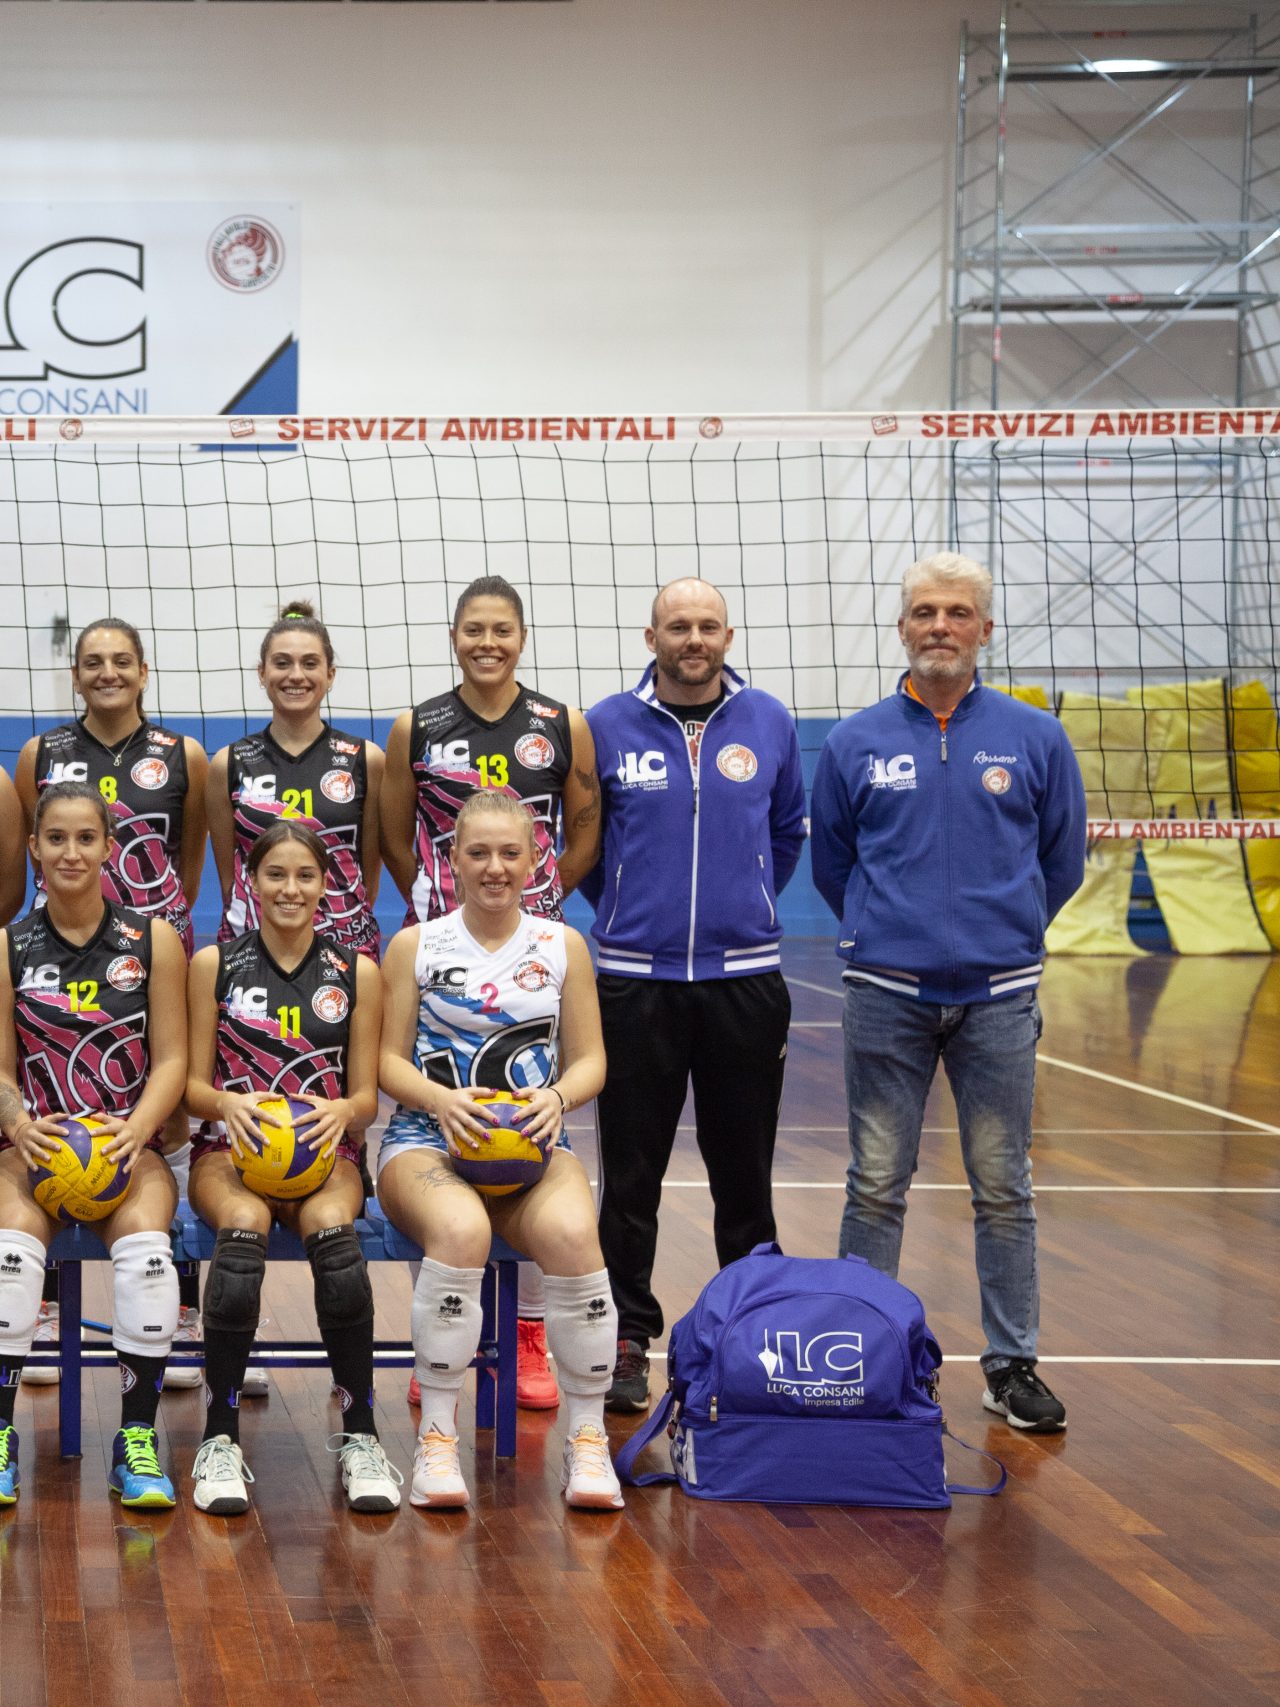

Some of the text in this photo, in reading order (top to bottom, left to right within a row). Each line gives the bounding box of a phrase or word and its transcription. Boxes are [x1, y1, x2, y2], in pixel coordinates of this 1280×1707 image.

[277, 416, 427, 441] SERVIZI
[441, 416, 676, 441] AMBIENTALI
[921, 412, 1075, 438] SERVIZI
[476, 754, 510, 788] 13
[623, 751, 668, 784] LC
[874, 754, 917, 783] LC
[973, 751, 1018, 765] Rossano
[99, 775, 118, 805] 8
[281, 788, 314, 819] 21
[1130, 822, 1280, 839] AMBIENTAL
[66, 980, 100, 1013] 12
[480, 982, 501, 1014] 2
[277, 1005, 300, 1039] 11
[772, 1331, 863, 1386] LC
[767, 1383, 865, 1398] LUCA CONSANI
[804, 1397, 865, 1407] Impresa Edile
